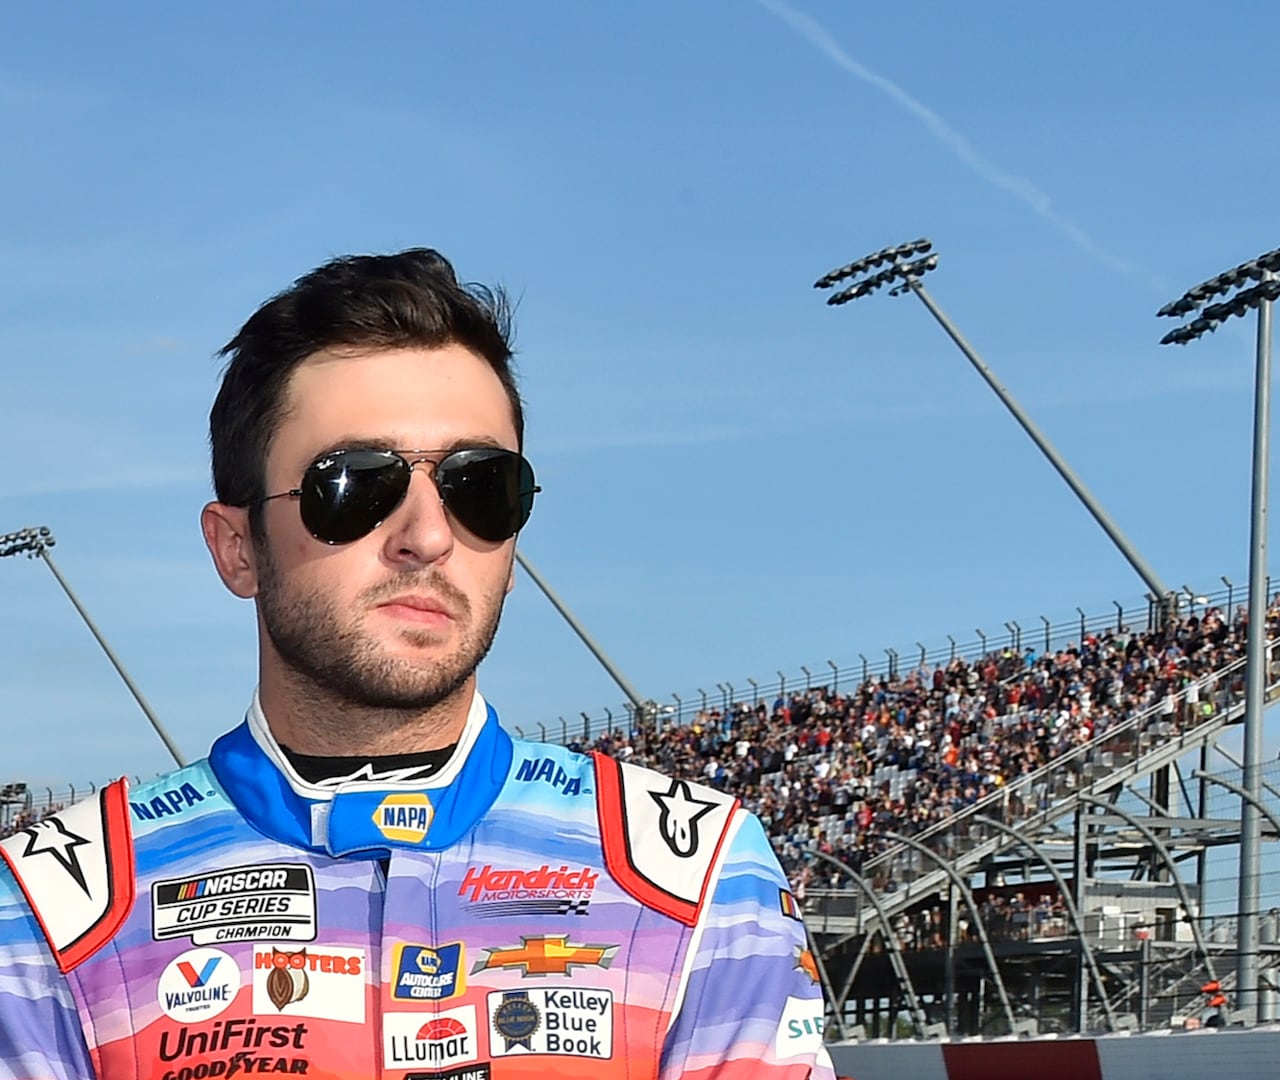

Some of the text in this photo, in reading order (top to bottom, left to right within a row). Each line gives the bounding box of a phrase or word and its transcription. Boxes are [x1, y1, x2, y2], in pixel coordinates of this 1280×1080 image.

[515, 757, 582, 797] NAPA
[132, 782, 205, 822] NAPA
[383, 806, 427, 829] NAPA
[204, 870, 287, 895] NASCAR
[458, 865, 599, 902] Hendrick
[481, 889, 592, 901] MOTORSPORTS
[177, 897, 291, 923] CUP SERIES
[216, 926, 292, 940] CHAMPION
[255, 951, 361, 975] HOOTERS
[165, 984, 229, 1010] VALVOLINE
[544, 990, 609, 1015] Kelley
[546, 1012, 597, 1032] Blue
[159, 1019, 308, 1061] UniFirst
[392, 1036, 468, 1062] LLumar
[546, 1034, 602, 1056] Book
